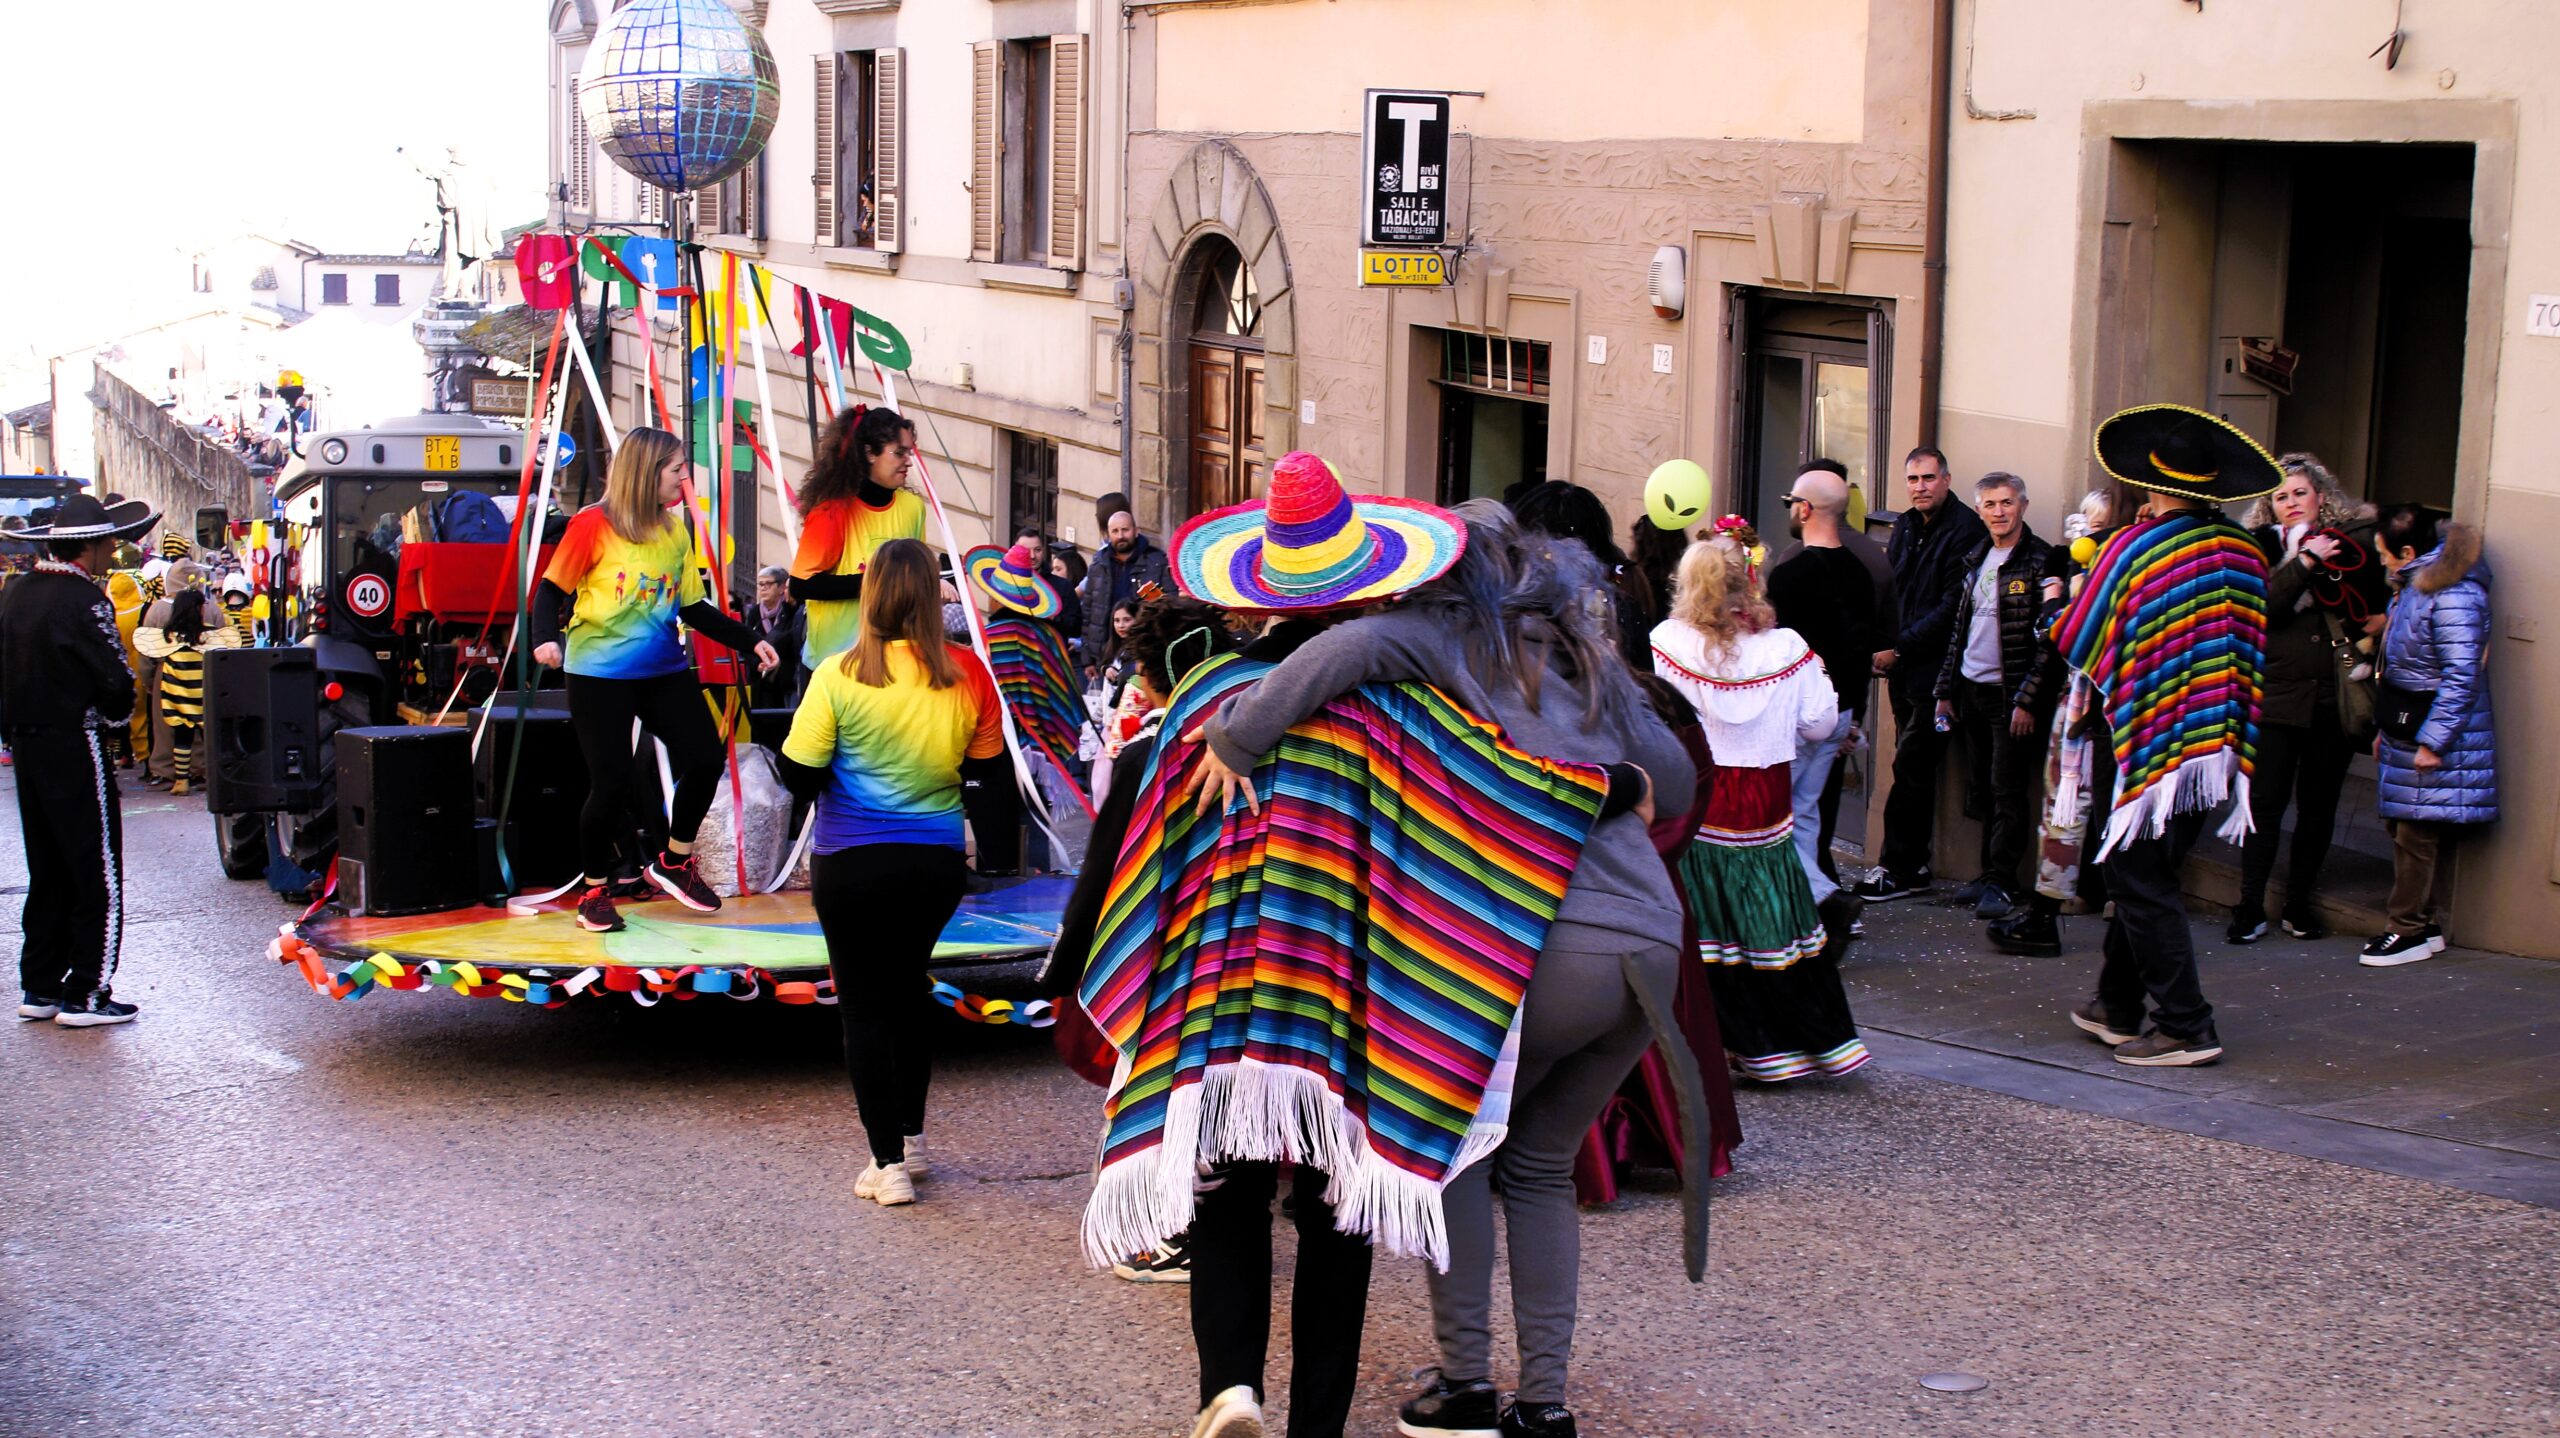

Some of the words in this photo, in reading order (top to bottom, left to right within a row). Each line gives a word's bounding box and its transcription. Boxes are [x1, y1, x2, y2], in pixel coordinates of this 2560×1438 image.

[1388, 102, 1437, 193] T
[1425, 178, 1433, 188] 3
[1390, 196, 1416, 209] SALI
[1421, 197, 1429, 209] E
[1380, 209, 1439, 227] TABACCHI
[1372, 258, 1439, 273] LOTTO
[1592, 341, 1603, 358] 74
[1657, 349, 1670, 367] 72
[425, 438, 441, 453] BT
[358, 587, 379, 603] 40
